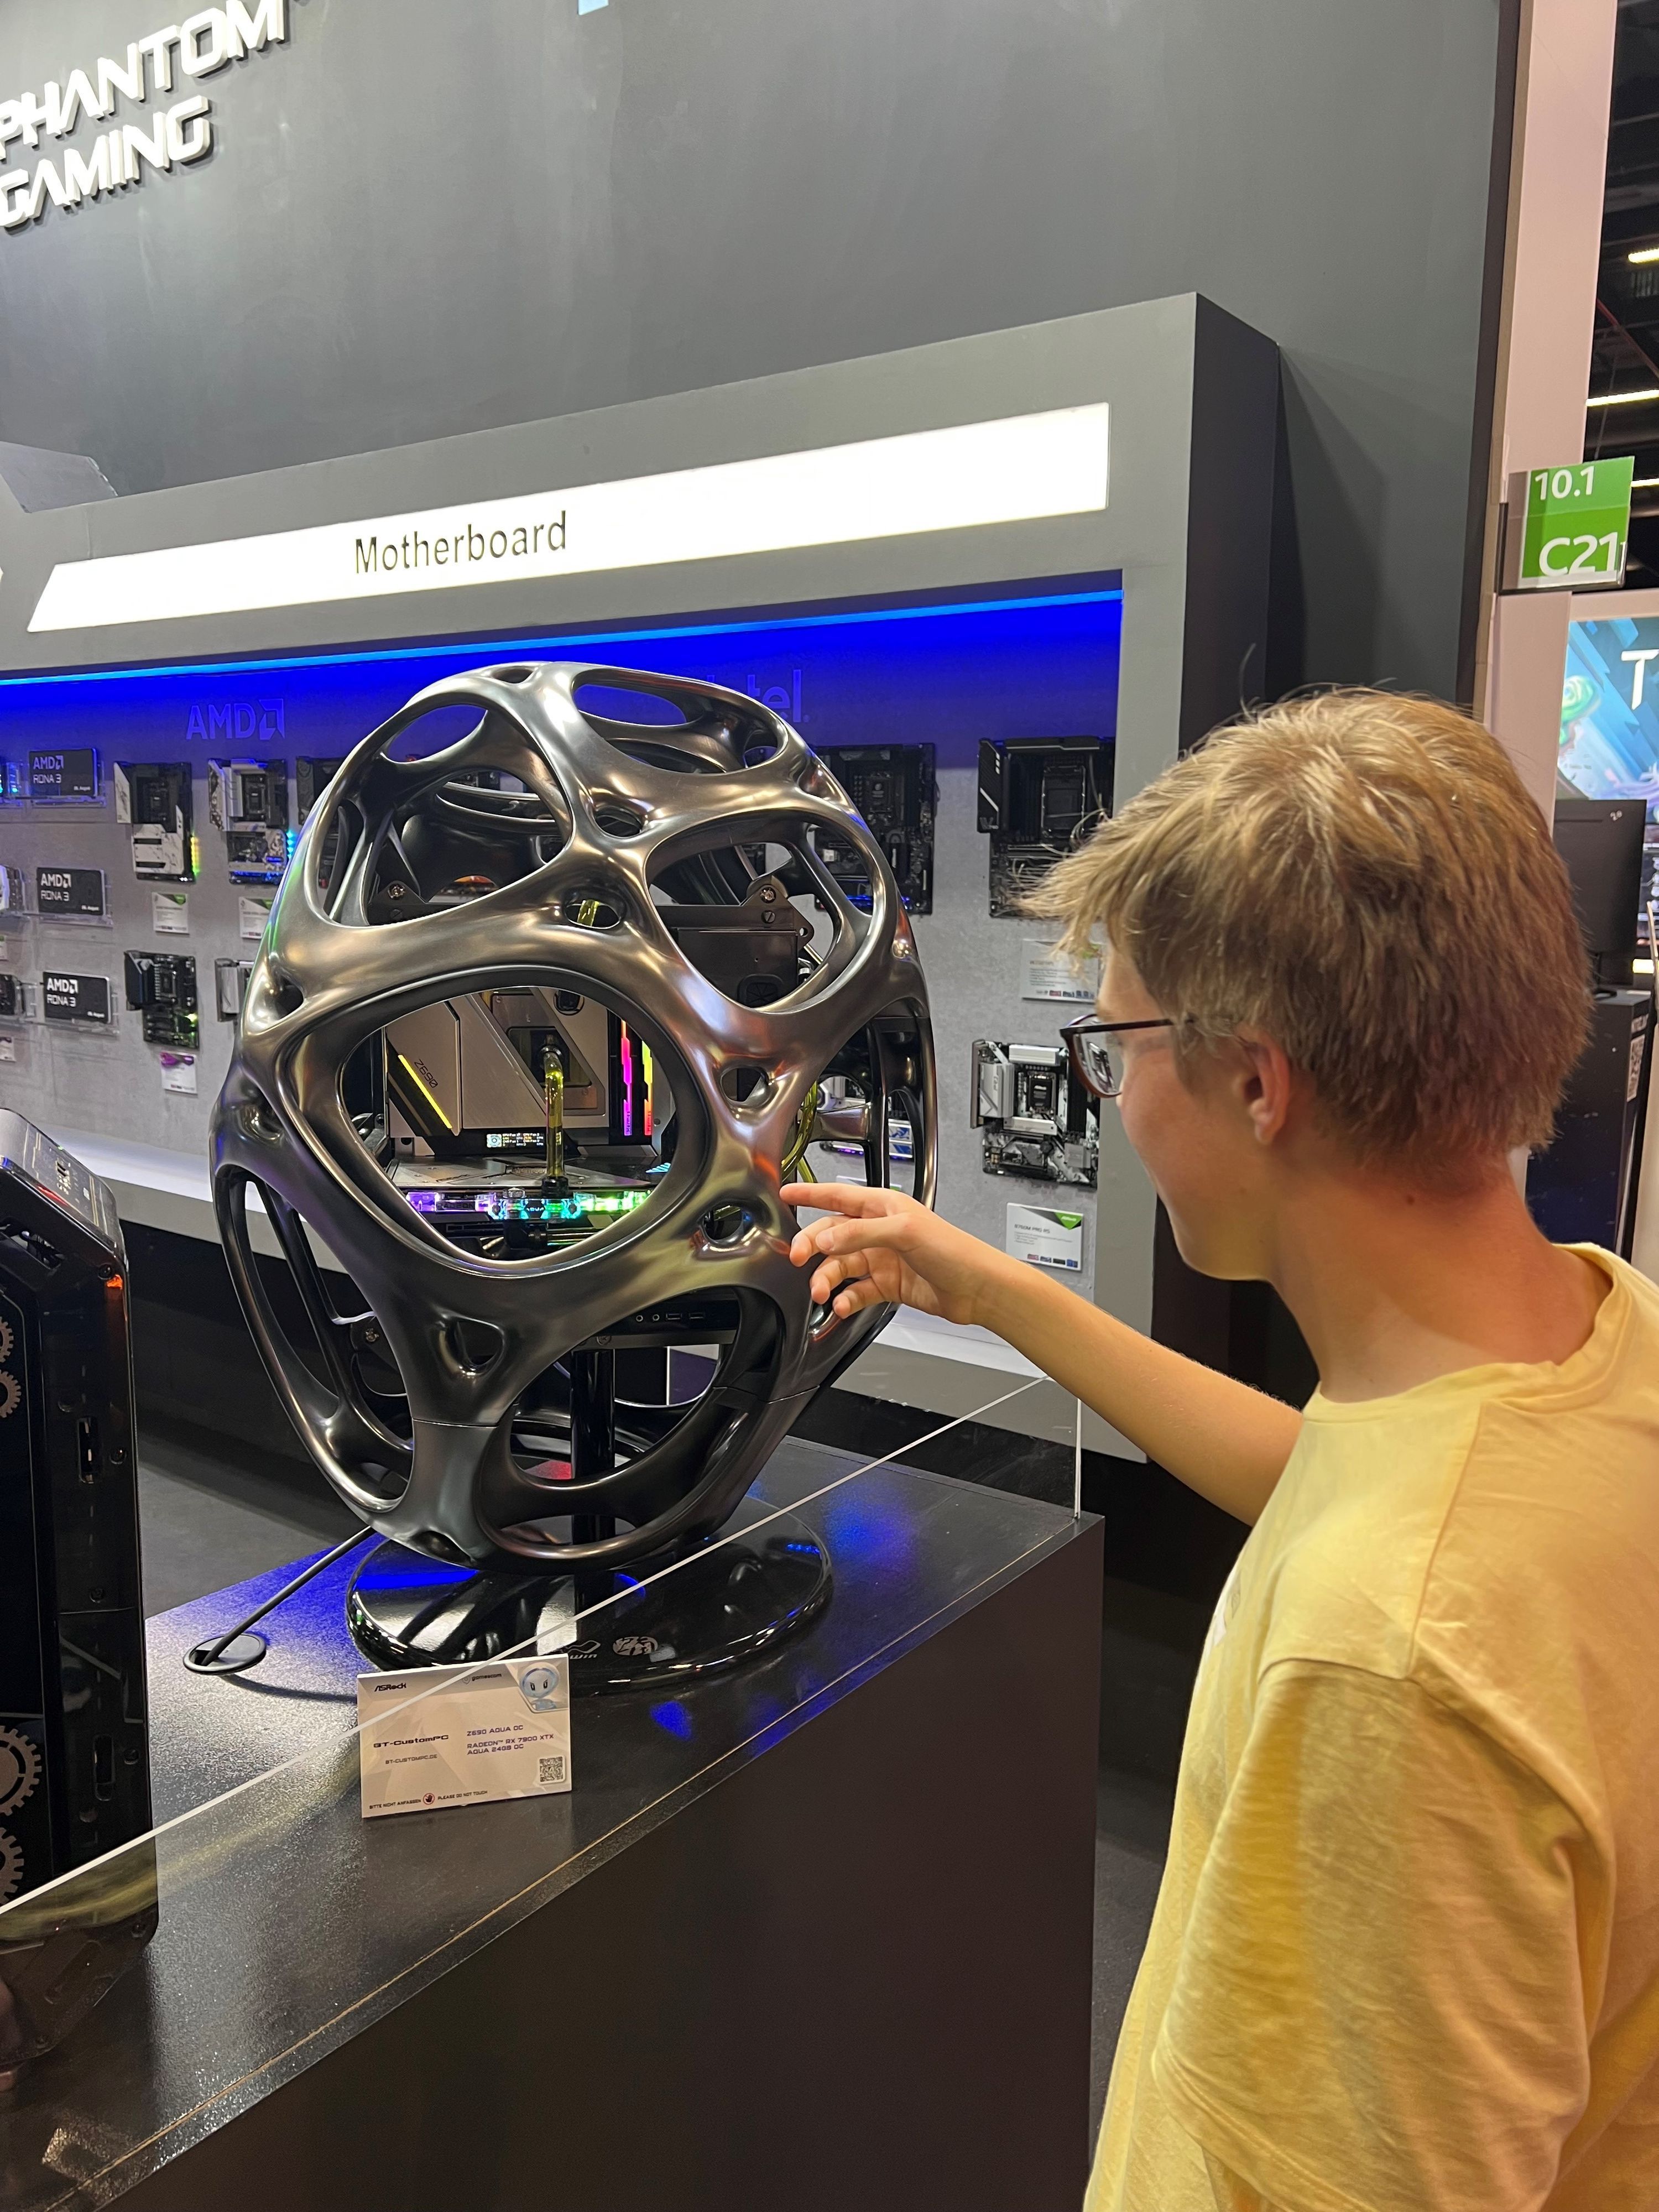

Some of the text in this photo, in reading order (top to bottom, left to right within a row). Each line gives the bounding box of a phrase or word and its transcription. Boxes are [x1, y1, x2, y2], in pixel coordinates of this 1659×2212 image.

[0, 0, 285, 160] PHANTOM
[0, 95, 210, 227] GAMING
[1535, 466, 1595, 500] 10.1
[355, 510, 567, 575] Motherboard
[1539, 531, 1618, 577] C21
[186, 703, 256, 740] AMD
[33, 756, 55, 770] AMD
[33, 774, 62, 784] RDNA 3
[41, 873, 63, 888] AMD
[41, 890, 69, 901] RDNA 3
[47, 978, 69, 993] AMD
[47, 994, 76, 1007] RDNA 3
[414, 1058, 438, 1088] Z690
[471, 1673, 502, 1682] gamescom
[374, 1682, 407, 1692] ASRock
